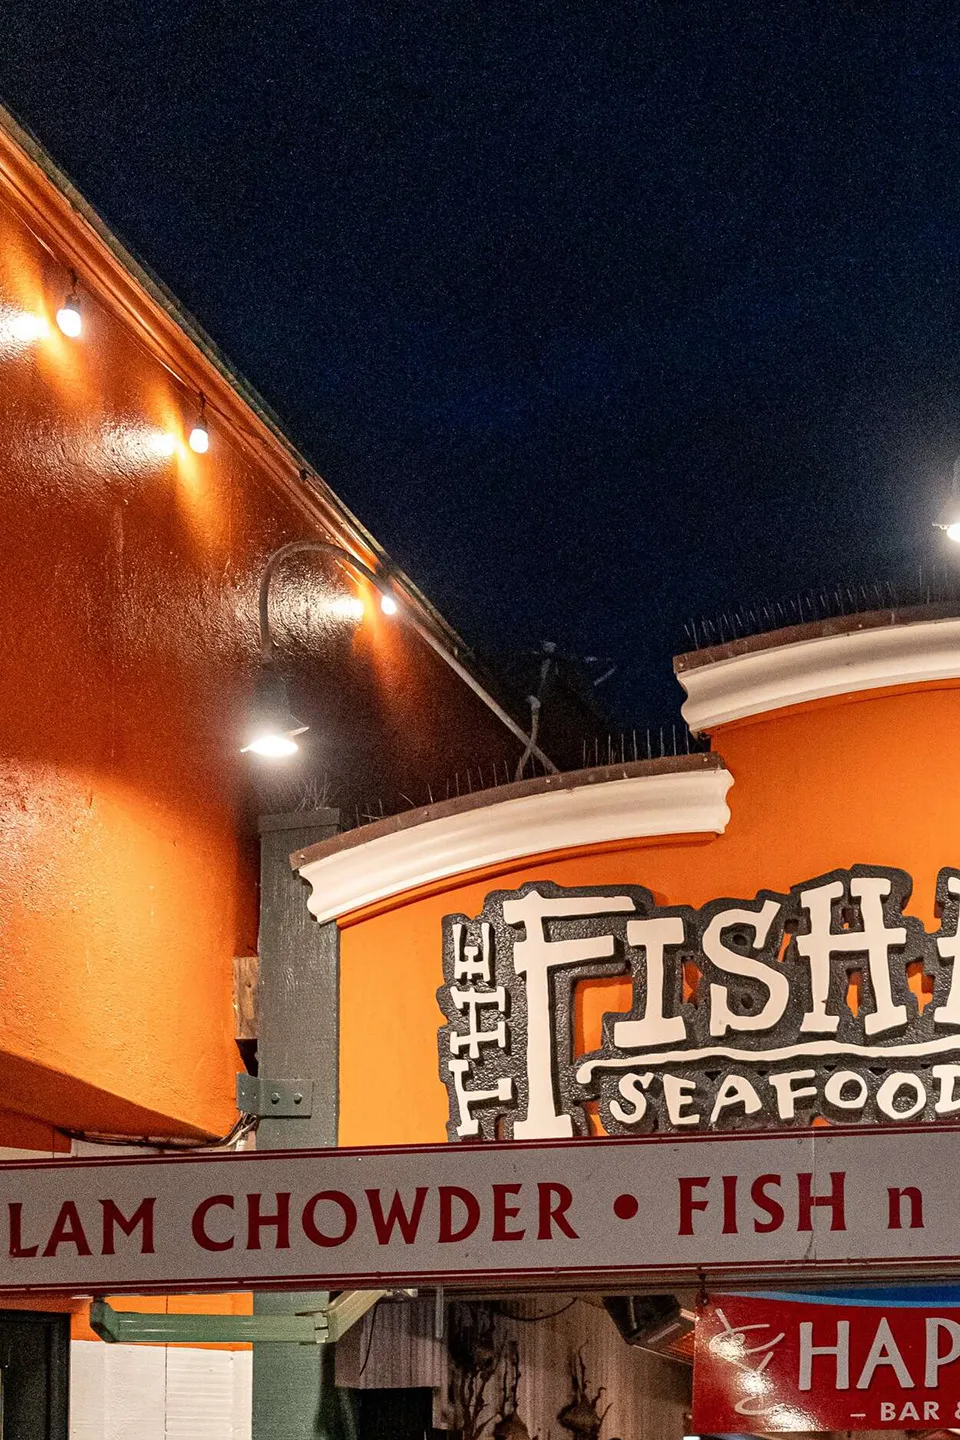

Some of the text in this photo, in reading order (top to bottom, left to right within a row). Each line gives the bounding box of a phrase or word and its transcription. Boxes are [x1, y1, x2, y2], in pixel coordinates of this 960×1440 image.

[448, 922, 512, 1136] THE
[503, 877, 906, 1138] FISH
[191, 1181, 581, 1253] CHOWDER
[677, 1171, 847, 1236] FISH
[887, 1187, 924, 1230] n
[879, 1401, 940, 1423] BAR
